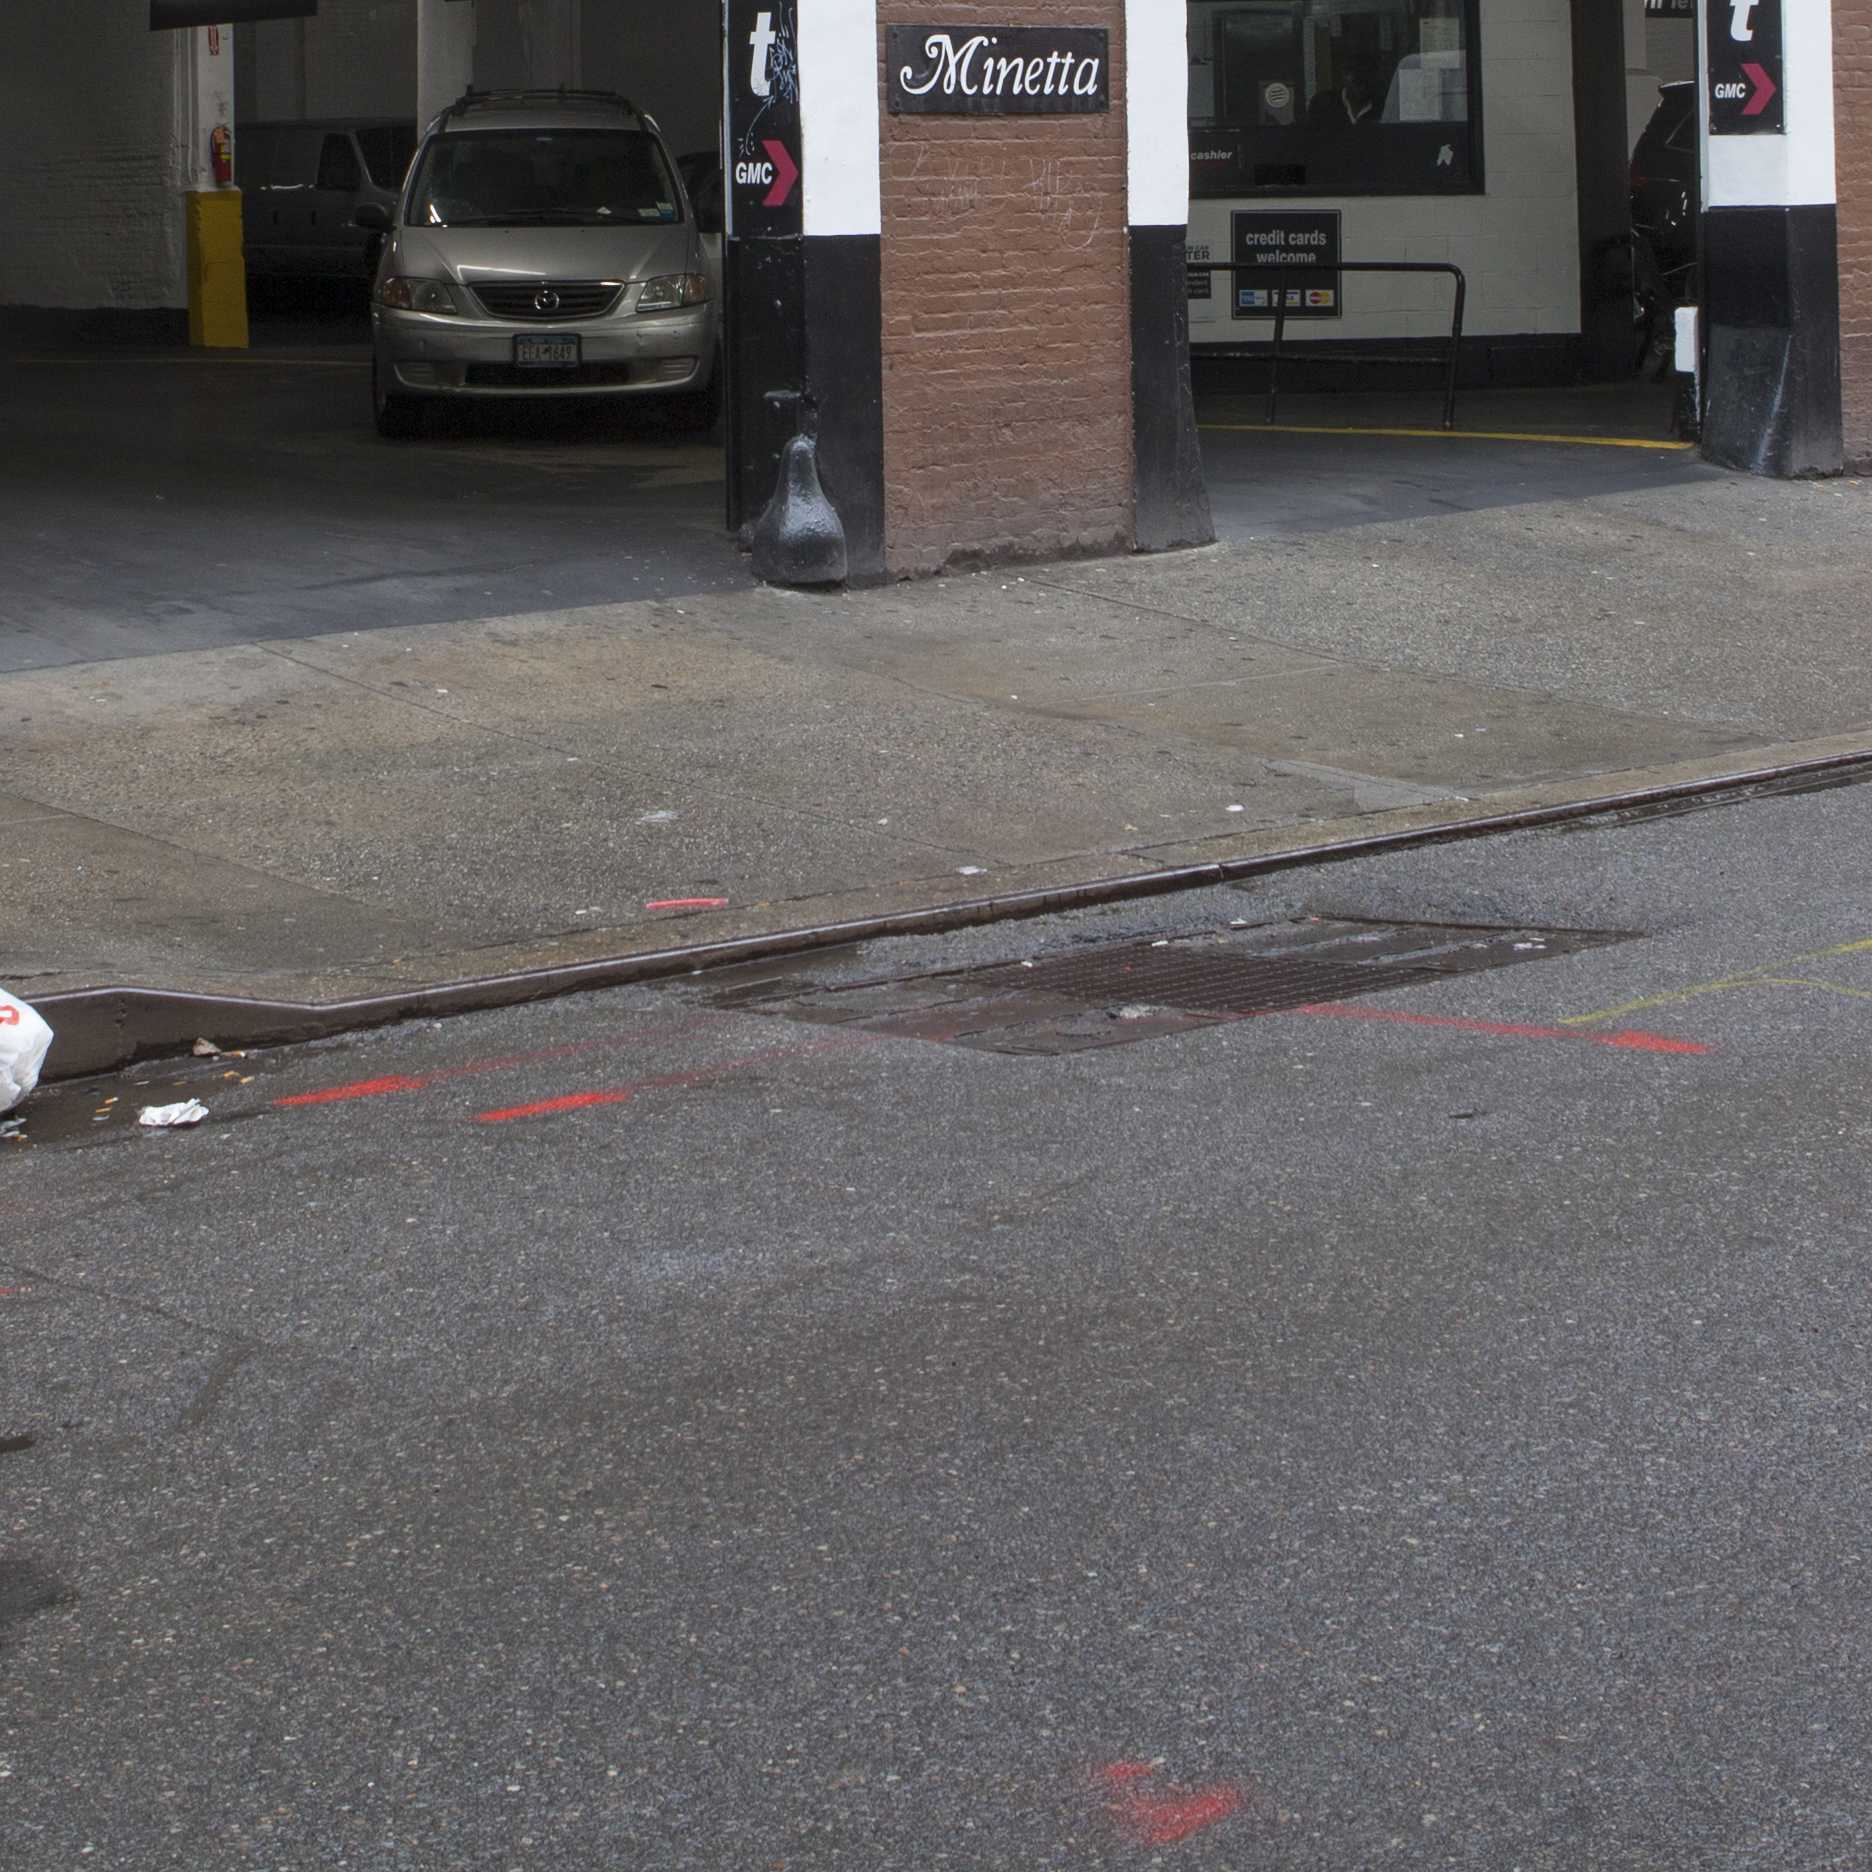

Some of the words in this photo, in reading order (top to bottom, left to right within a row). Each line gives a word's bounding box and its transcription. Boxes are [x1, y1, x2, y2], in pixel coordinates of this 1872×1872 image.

[899, 33, 1100, 96] Minetta
[1714, 82, 1747, 99] GMC
[1190, 149, 1233, 161] cashier
[735, 161, 774, 186] GMC
[1245, 229, 1285, 246] credit
[1288, 229, 1328, 246] cards
[1256, 250, 1317, 264] welcome
